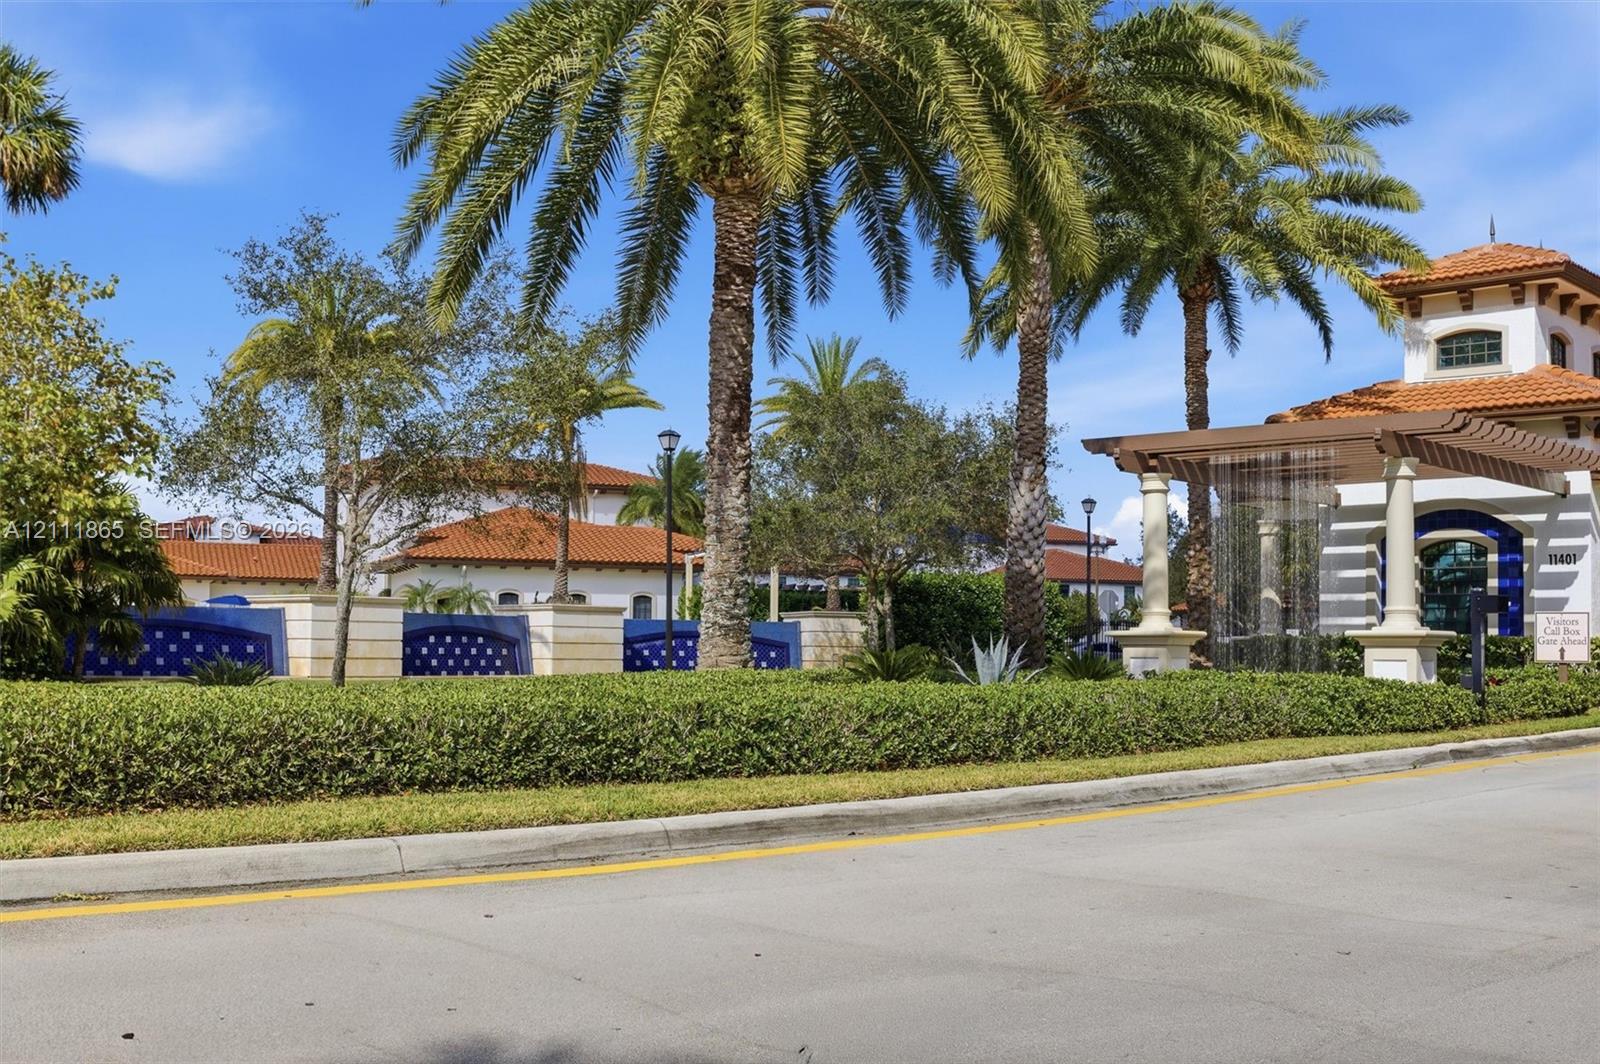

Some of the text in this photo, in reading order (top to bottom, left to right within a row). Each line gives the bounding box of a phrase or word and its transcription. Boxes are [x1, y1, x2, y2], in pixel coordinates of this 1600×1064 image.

[1548, 554, 1577, 565] 11401
[1546, 617, 1579, 626] Visitors
[1543, 627, 1581, 636] Call Box
[1537, 636, 1587, 646] Gate Ahead
